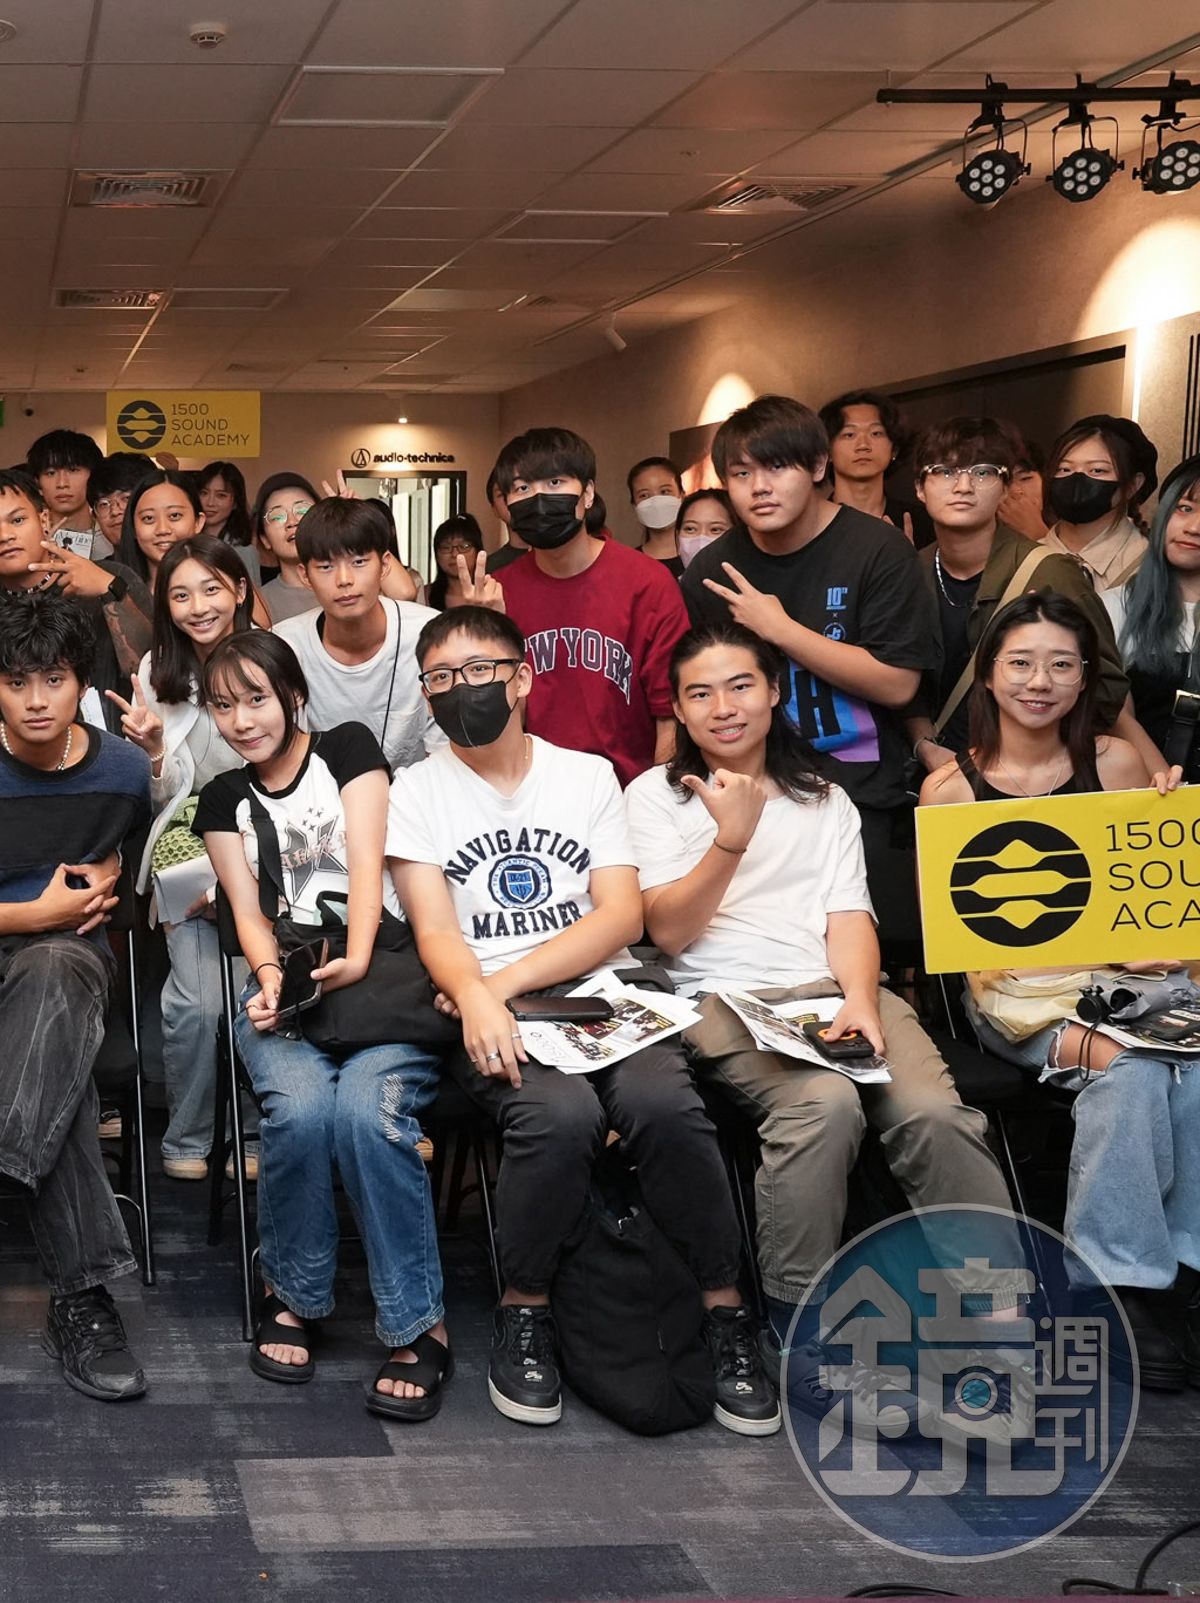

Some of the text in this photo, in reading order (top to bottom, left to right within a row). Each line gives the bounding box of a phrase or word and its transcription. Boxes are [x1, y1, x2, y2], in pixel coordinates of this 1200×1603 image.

[171, 403, 209, 415] 1500
[171, 418, 228, 431] SOUND
[171, 434, 249, 446] ACADEMY
[373, 451, 455, 463] audio-technica
[444, 827, 591, 885] NAVIGATION
[472, 900, 583, 940] MARINER
